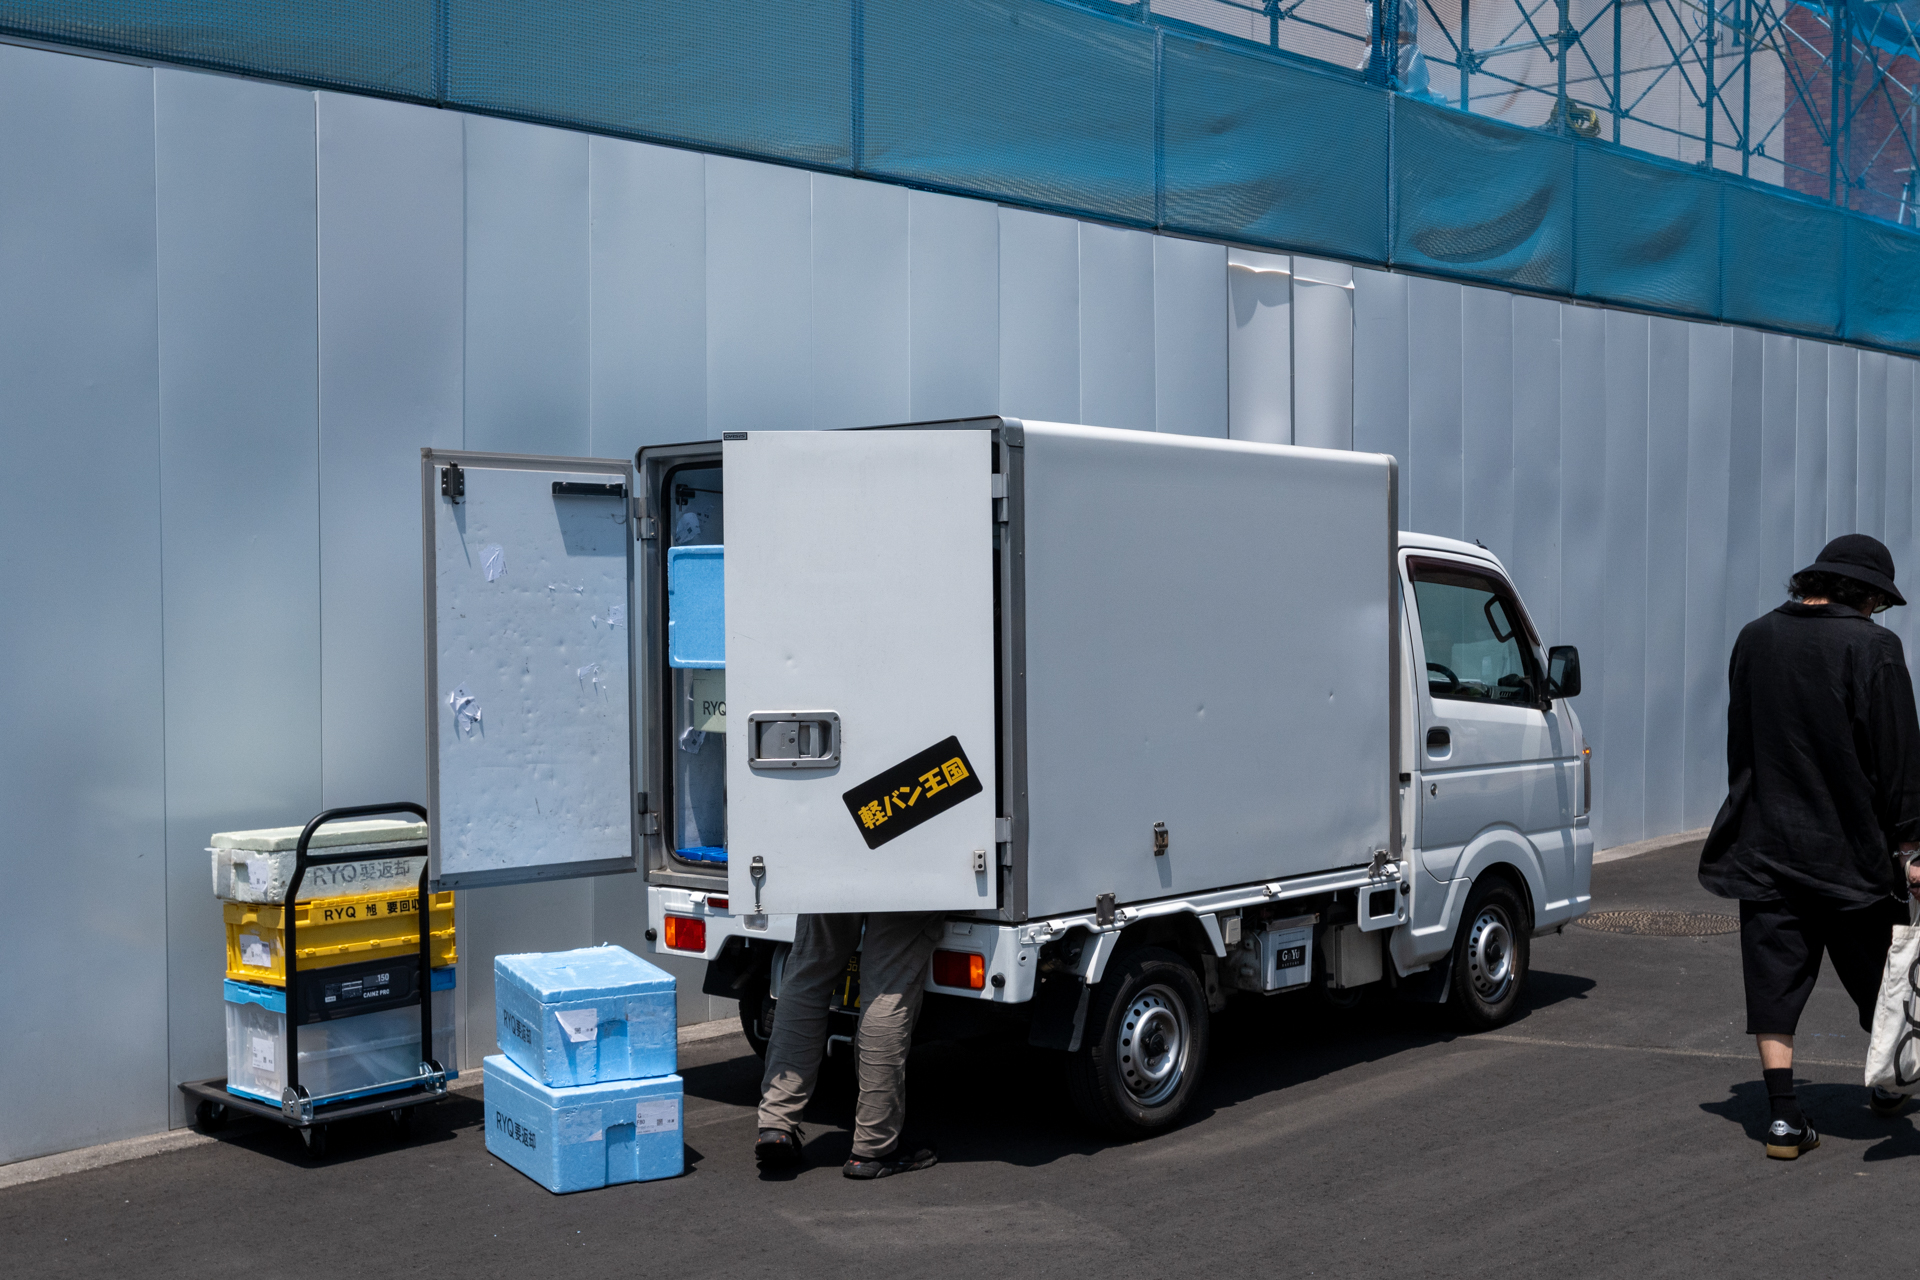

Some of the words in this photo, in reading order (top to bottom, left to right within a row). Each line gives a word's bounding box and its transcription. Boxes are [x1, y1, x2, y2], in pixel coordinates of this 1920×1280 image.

[703, 701, 726, 716] RYQ
[857, 757, 970, 830] 軽バン王国
[324, 905, 356, 921] RYQ
[366, 903, 378, 917] 旭
[377, 973, 389, 982] 150
[363, 990, 379, 998] CAINZ
